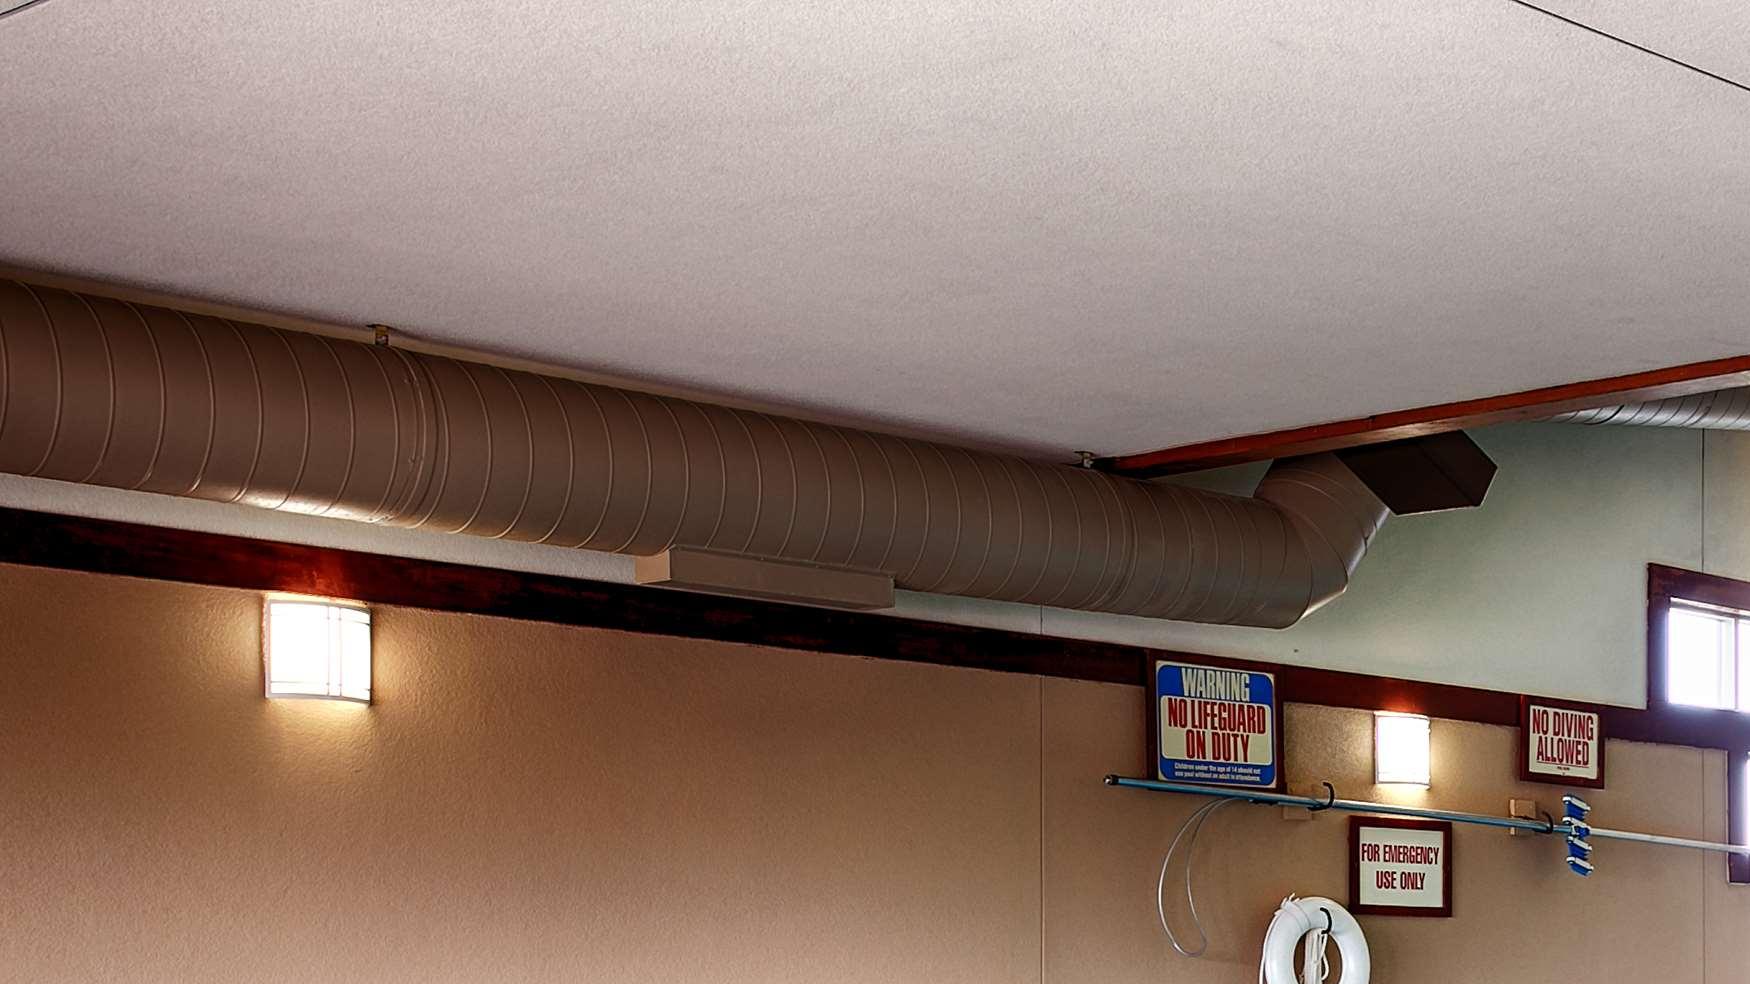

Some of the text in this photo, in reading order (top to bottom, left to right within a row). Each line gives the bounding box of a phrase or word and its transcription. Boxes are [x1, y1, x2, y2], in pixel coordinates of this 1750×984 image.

[1181, 667, 1250, 702] WARNING
[1168, 697, 1266, 734] NO LIFEGUARD
[1532, 708, 1594, 741] NO DIVING
[1186, 729, 1249, 762] ON DUTY
[1536, 735, 1589, 766] ALLOWED
[1361, 843, 1439, 865] FOR EMERGENCY
[1376, 870, 1426, 890] USE ONLY
